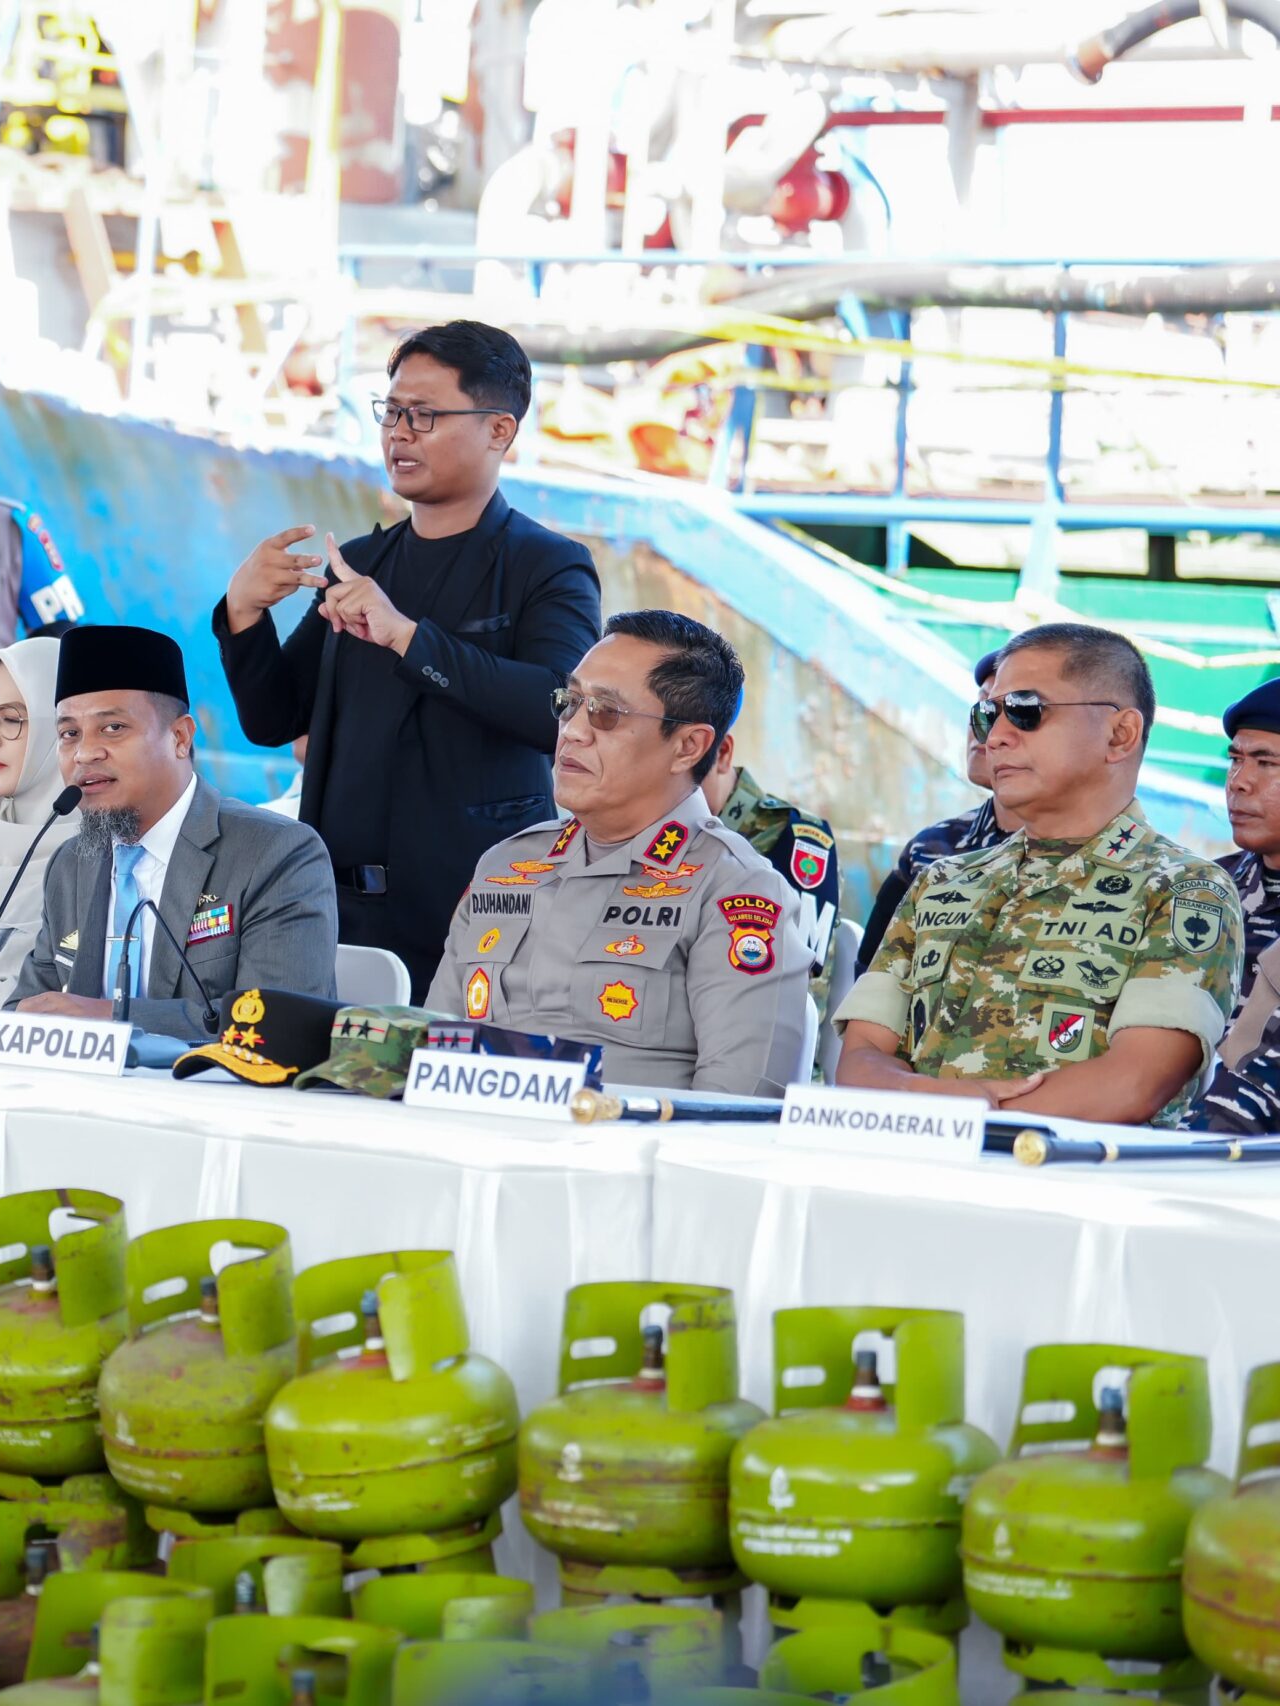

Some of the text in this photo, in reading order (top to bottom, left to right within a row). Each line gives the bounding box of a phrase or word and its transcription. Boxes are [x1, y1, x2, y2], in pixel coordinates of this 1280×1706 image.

[472, 893, 531, 915] DJUHANDANI
[723, 897, 776, 914] POLDA
[603, 905, 681, 927] POLRI
[1043, 921, 1138, 946] TNI AD
[414, 1062, 572, 1105] PANGDAM
[788, 1105, 974, 1140] DANKODAERAL VI
